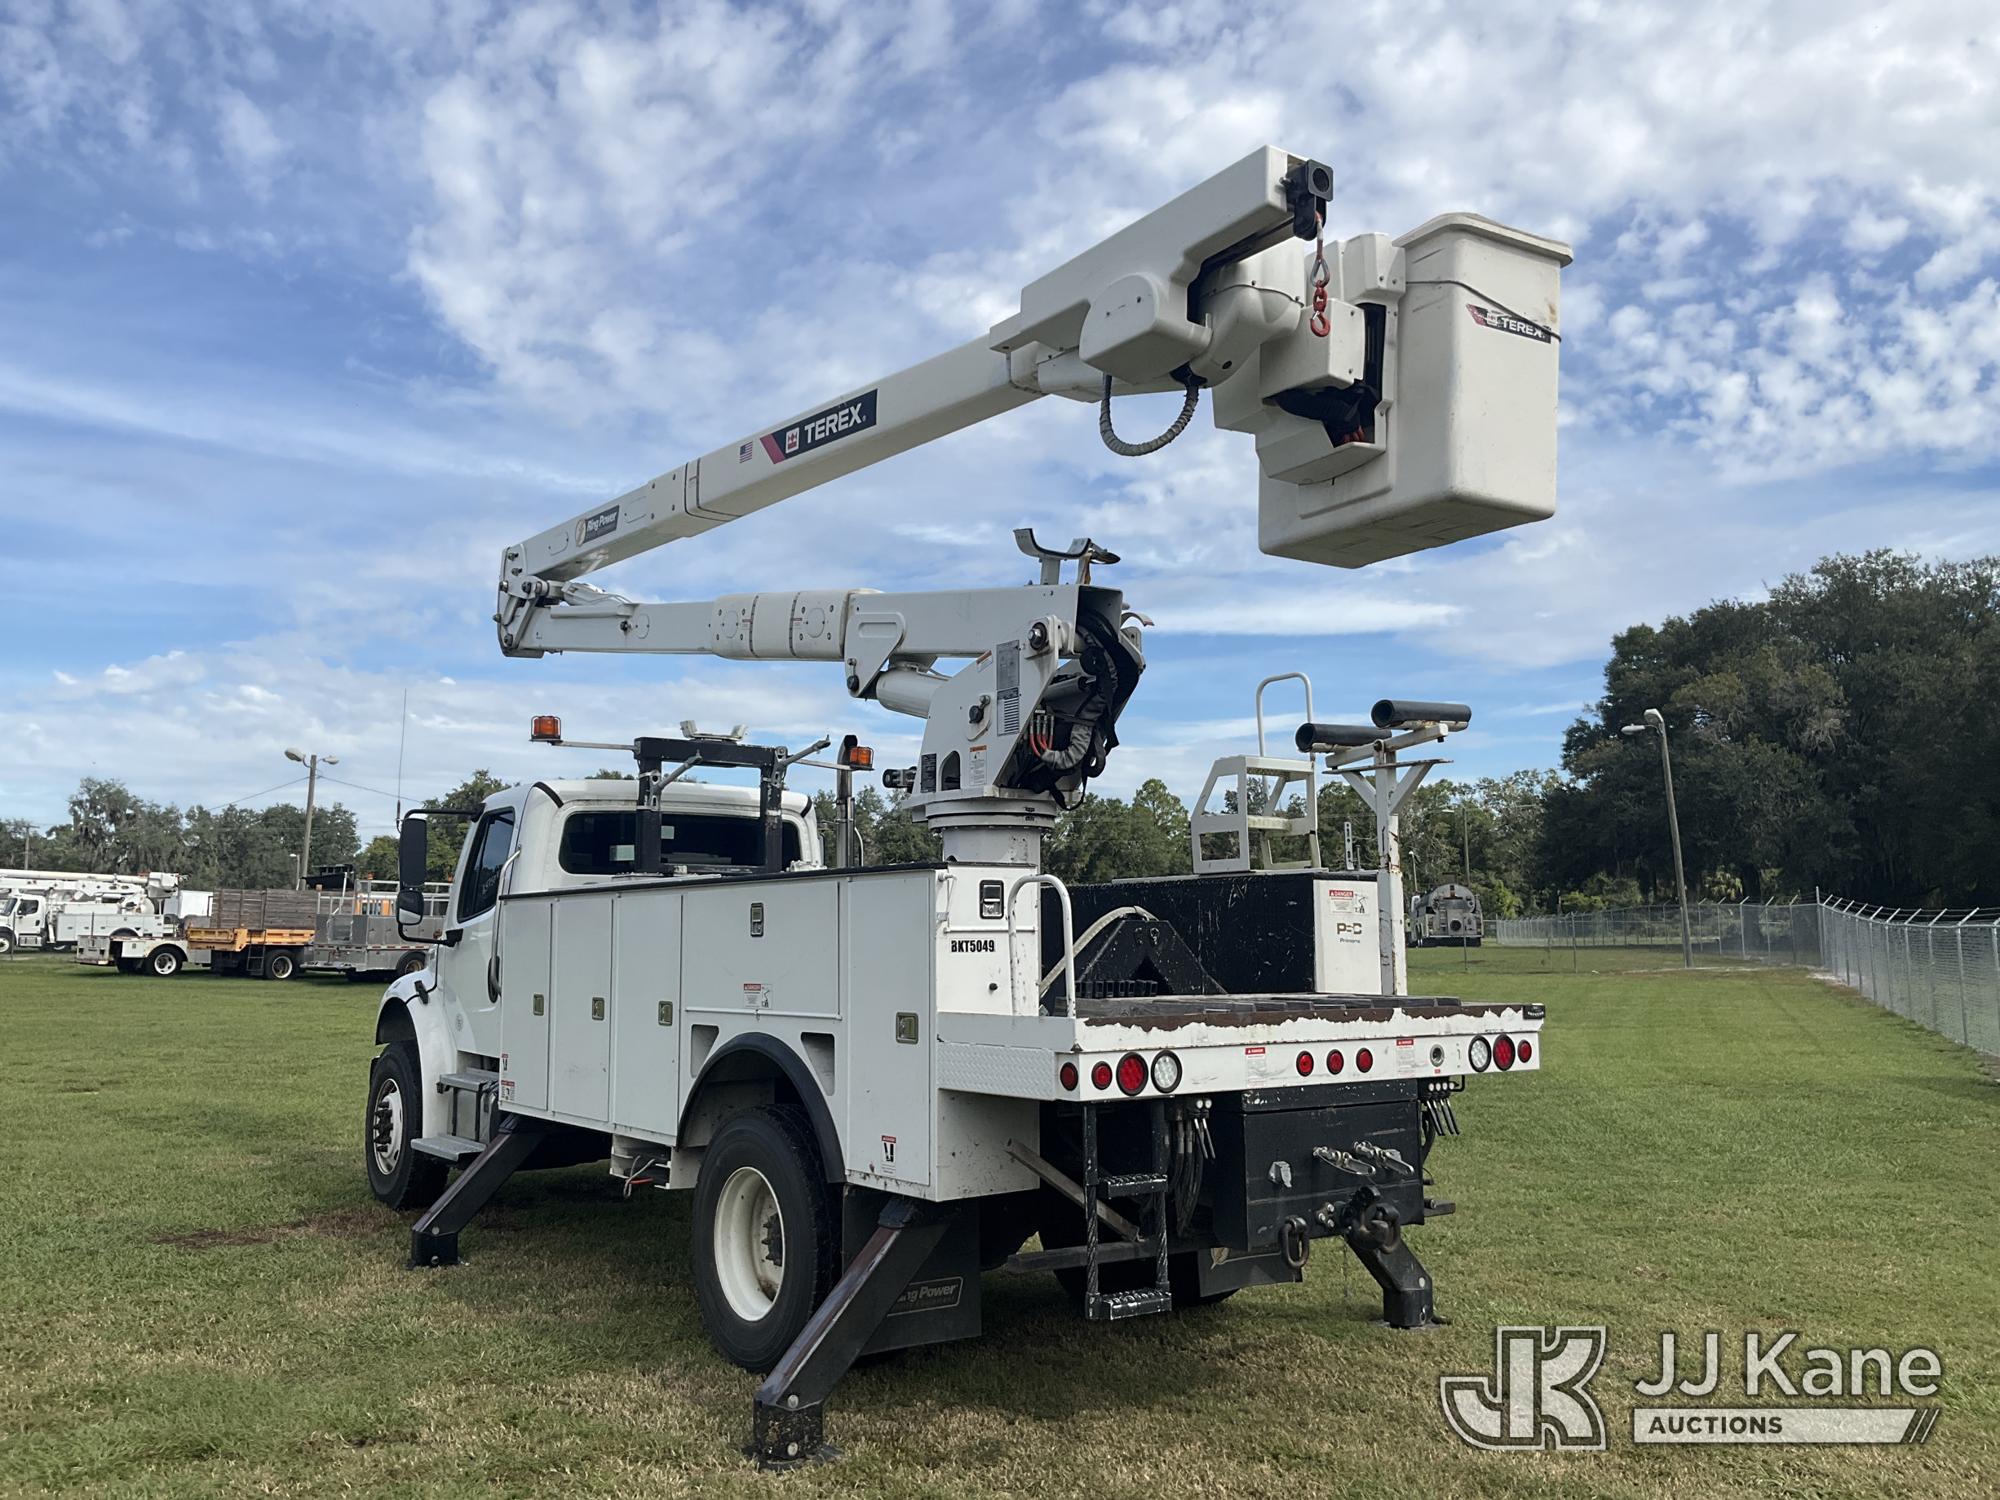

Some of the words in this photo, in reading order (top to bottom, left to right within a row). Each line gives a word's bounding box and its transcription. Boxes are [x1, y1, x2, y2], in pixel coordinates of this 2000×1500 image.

[1500, 317, 1543, 338] TEREX
[804, 402, 863, 444] TEREX
[950, 940, 995, 952] BKT5049
[918, 1284, 958, 1299] Power
